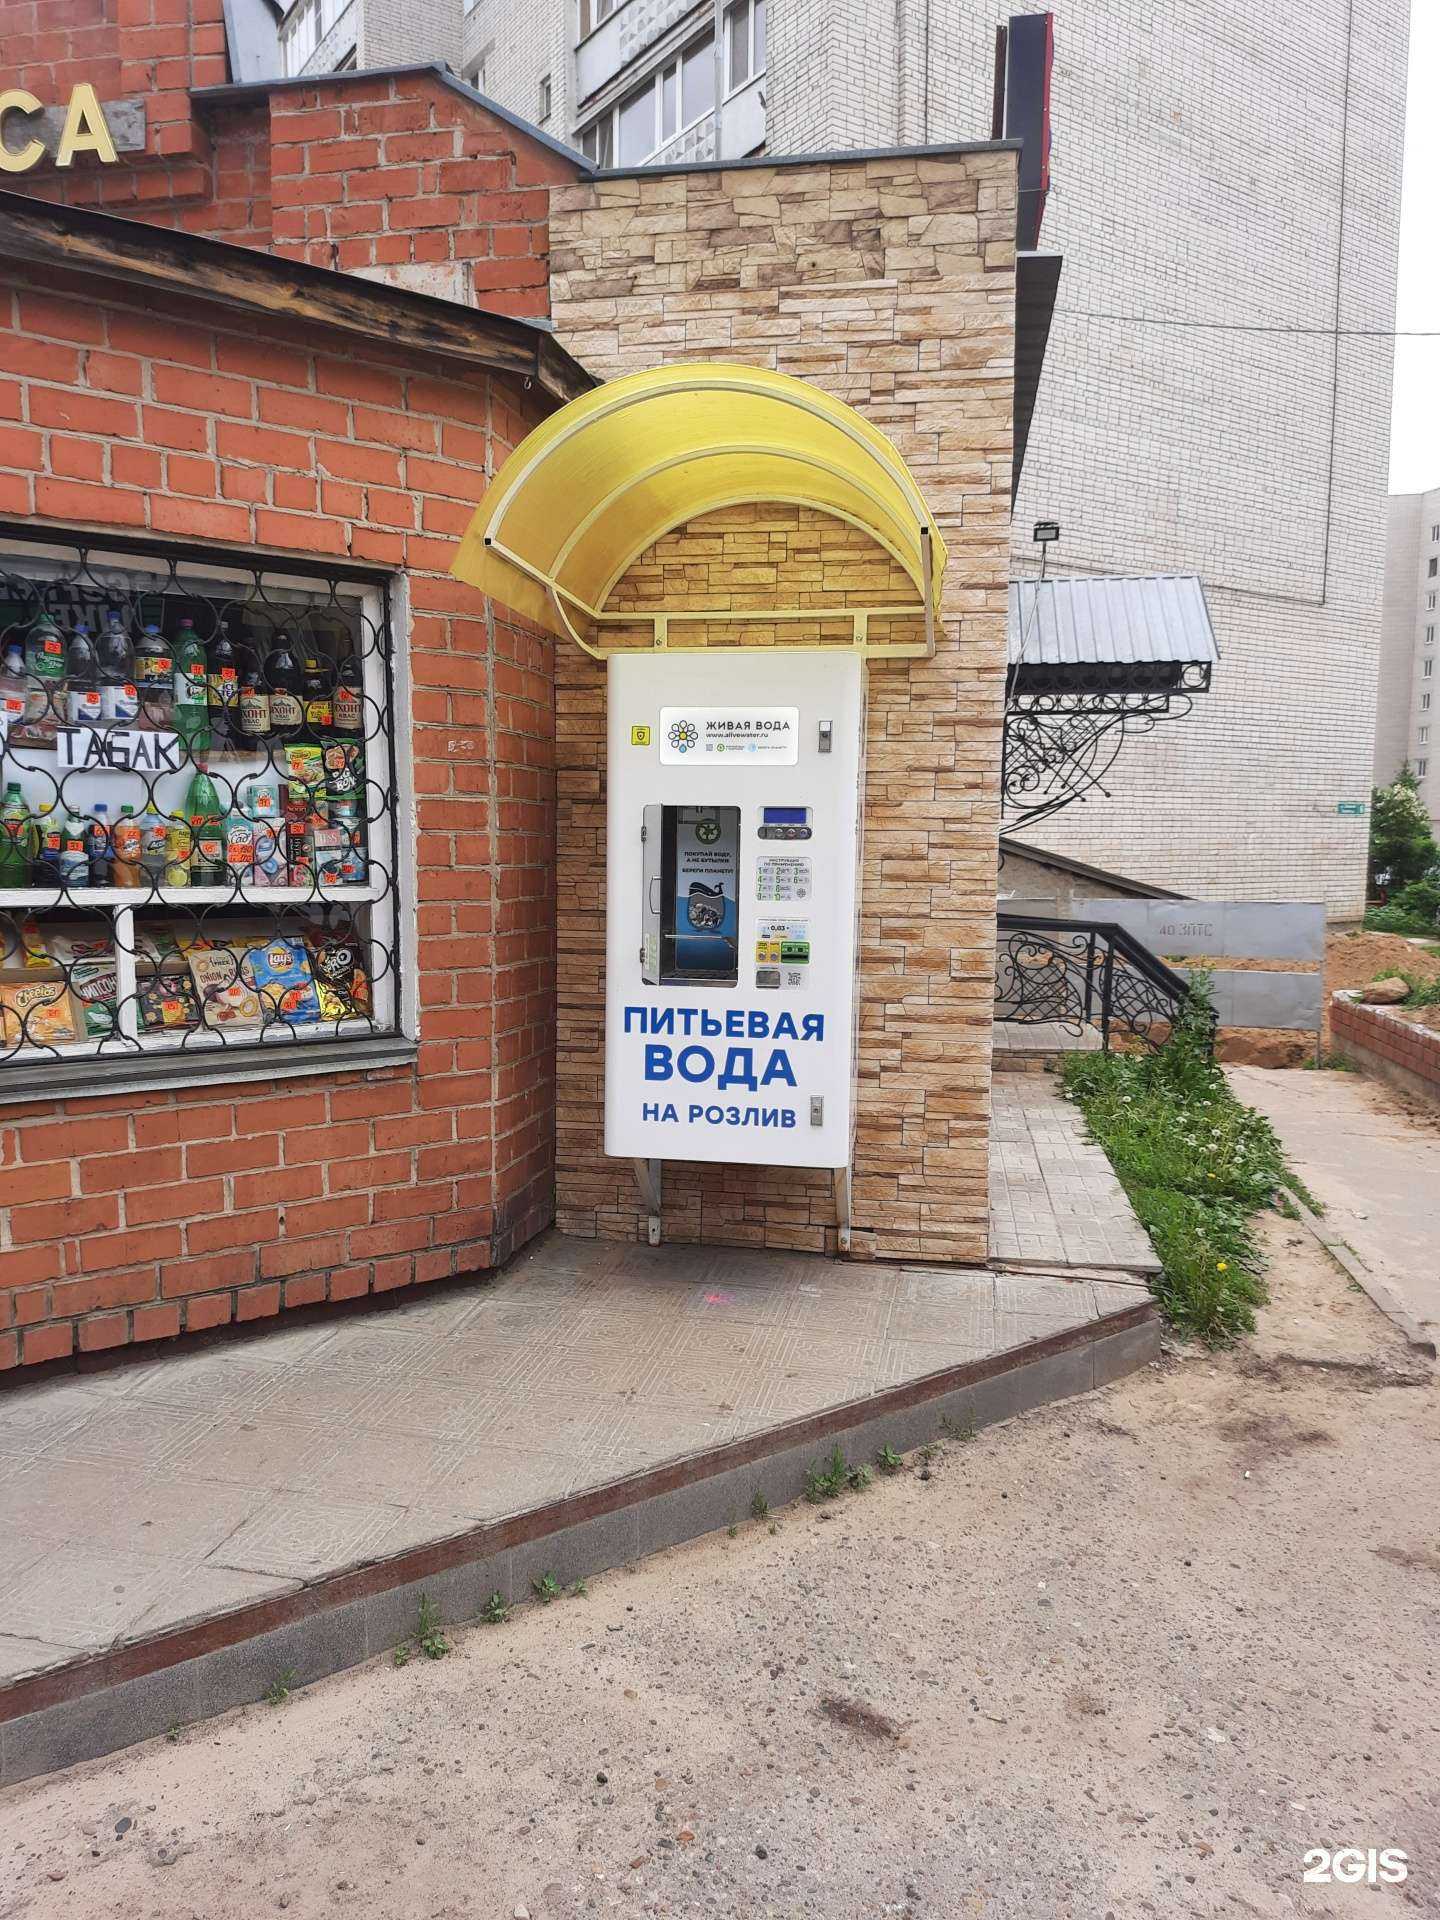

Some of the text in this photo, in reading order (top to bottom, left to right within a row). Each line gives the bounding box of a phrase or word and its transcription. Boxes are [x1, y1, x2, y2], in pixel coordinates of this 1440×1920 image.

[706, 721, 790, 732] ЖИВАЯ ВОДА
[57, 727, 179, 770] ТАБАК
[269, 953, 293, 968] Lay's
[16, 984, 56, 1008] Cheetos
[623, 1006, 825, 1042] ПИТЬЕВАЯ
[644, 1043, 798, 1092] ВОДА
[642, 1102, 797, 1129] НА РОЗЛИВ
